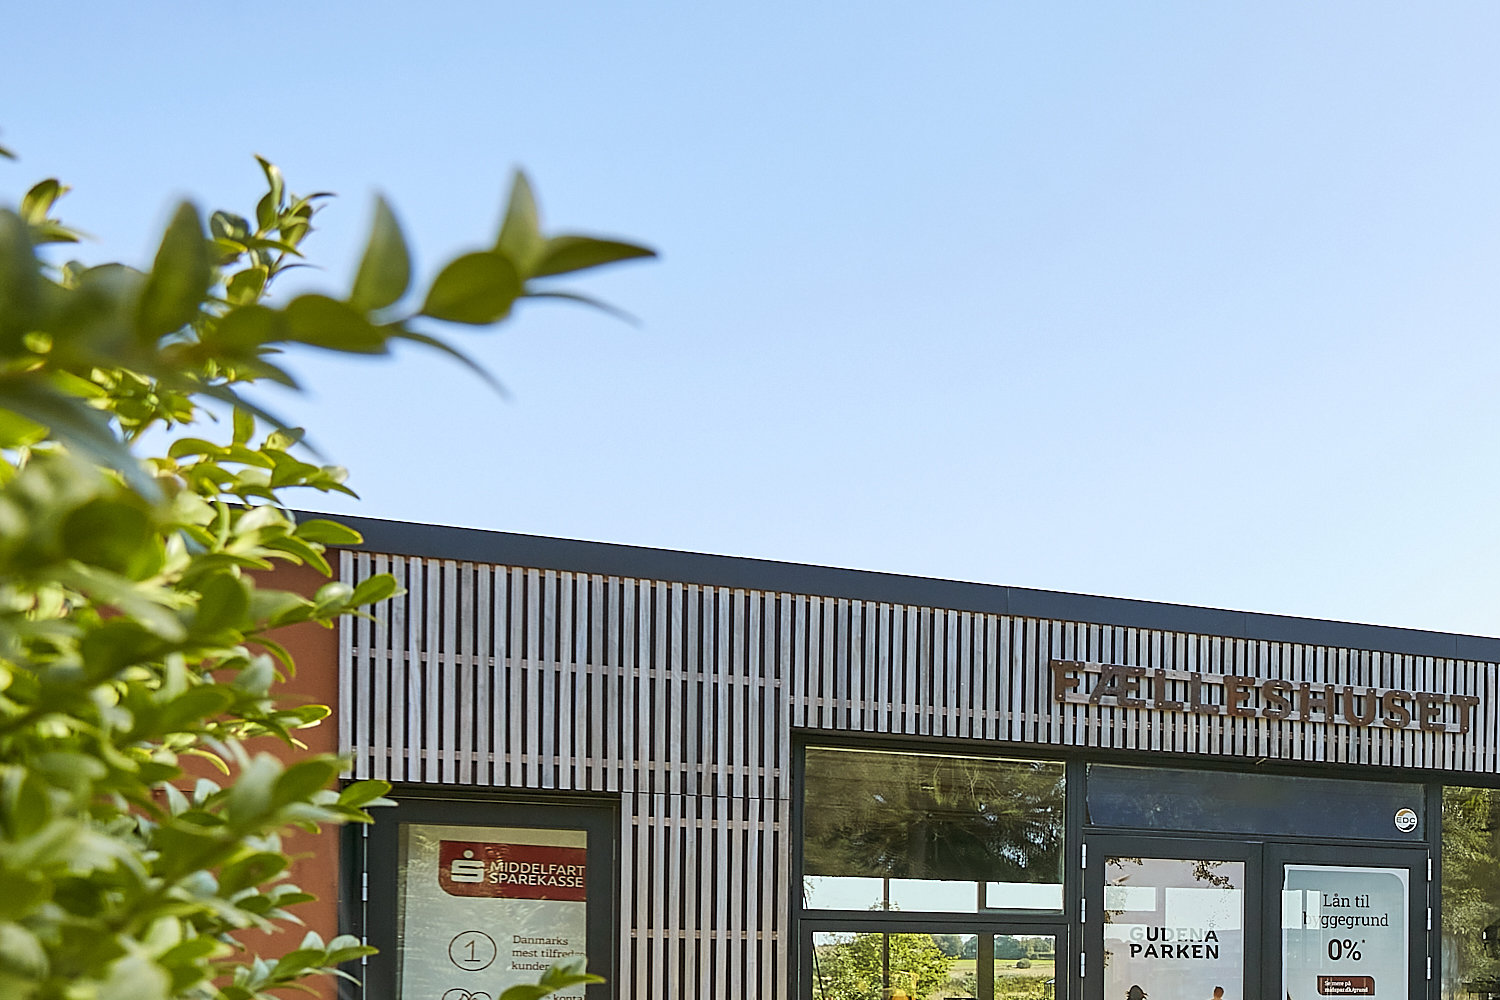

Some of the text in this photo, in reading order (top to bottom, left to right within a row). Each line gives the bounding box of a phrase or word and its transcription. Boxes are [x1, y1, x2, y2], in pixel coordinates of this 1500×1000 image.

[1051, 660, 1480, 734] FÆLLESHUSET
[489, 861, 586, 876] MIDDELFART
[489, 872, 585, 888] SPAREKASSE
[1323, 893, 1370, 908] Lån til
[513, 935, 569, 946] Danmarks
[512, 949, 539, 958] mest
[1129, 944, 1219, 959] PARKEN
